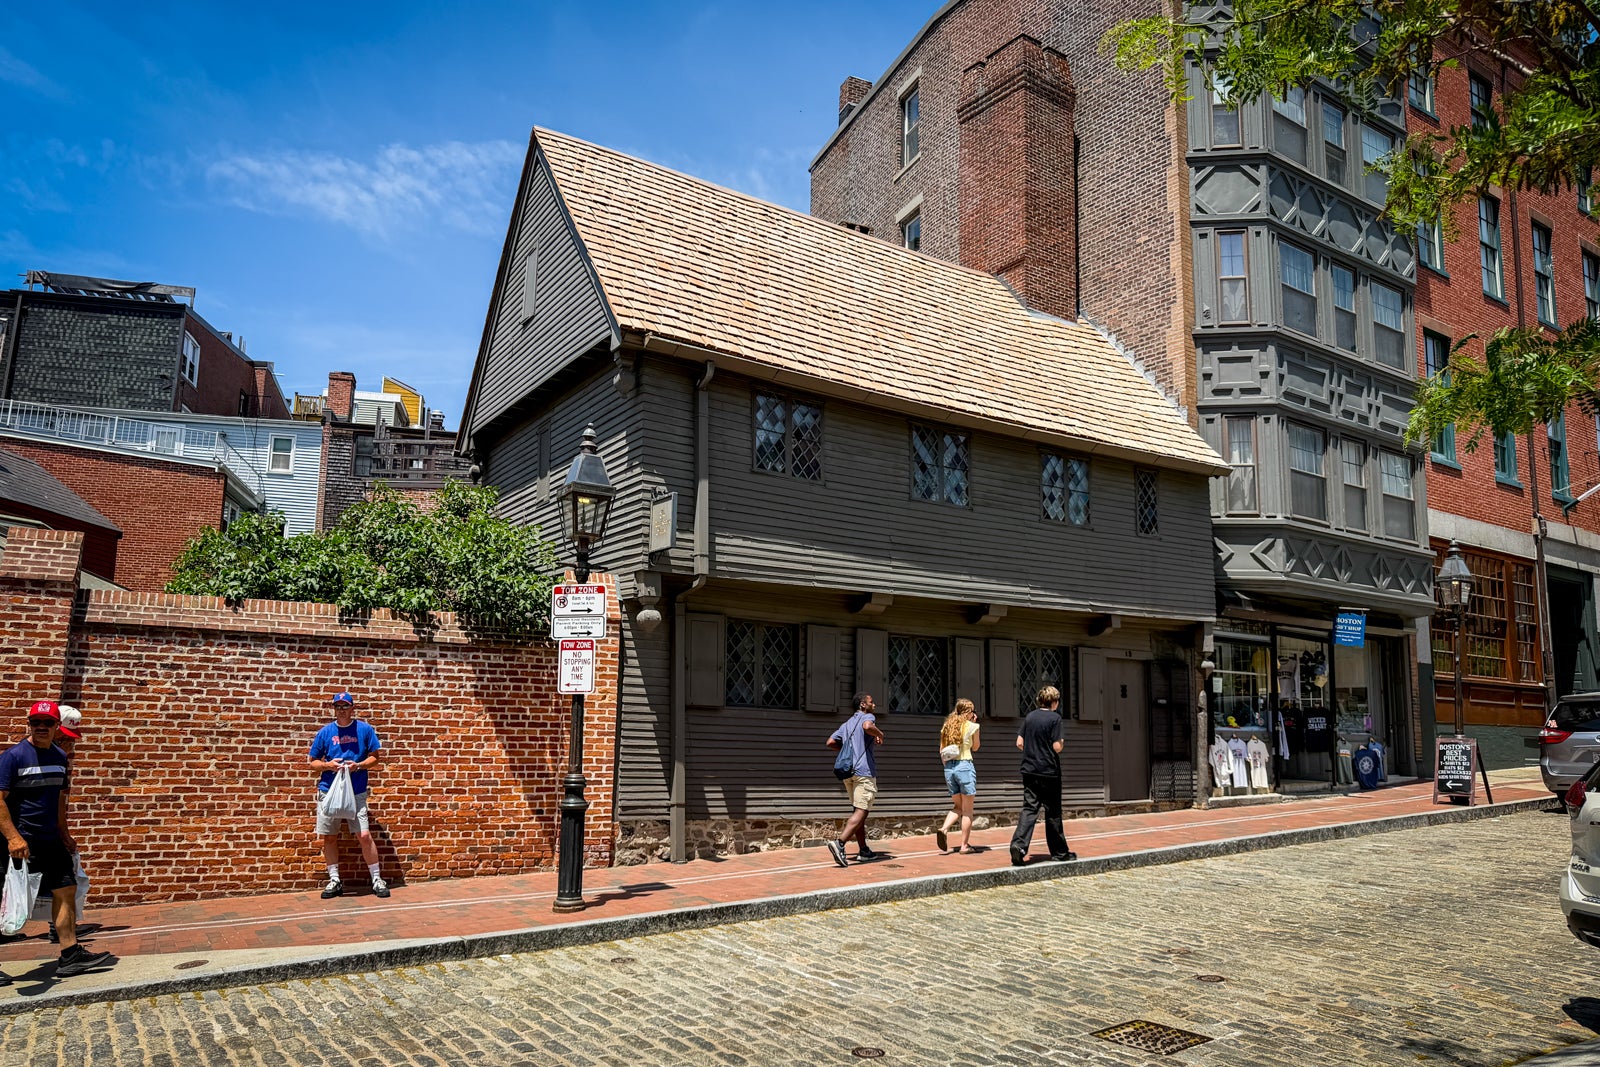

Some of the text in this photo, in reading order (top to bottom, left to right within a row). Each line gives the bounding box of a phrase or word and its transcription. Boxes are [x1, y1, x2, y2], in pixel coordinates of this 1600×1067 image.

[561, 586, 598, 594] TOW ZONE
[1336, 617, 1362, 625] BOSTON
[571, 673, 583, 681] TIME
